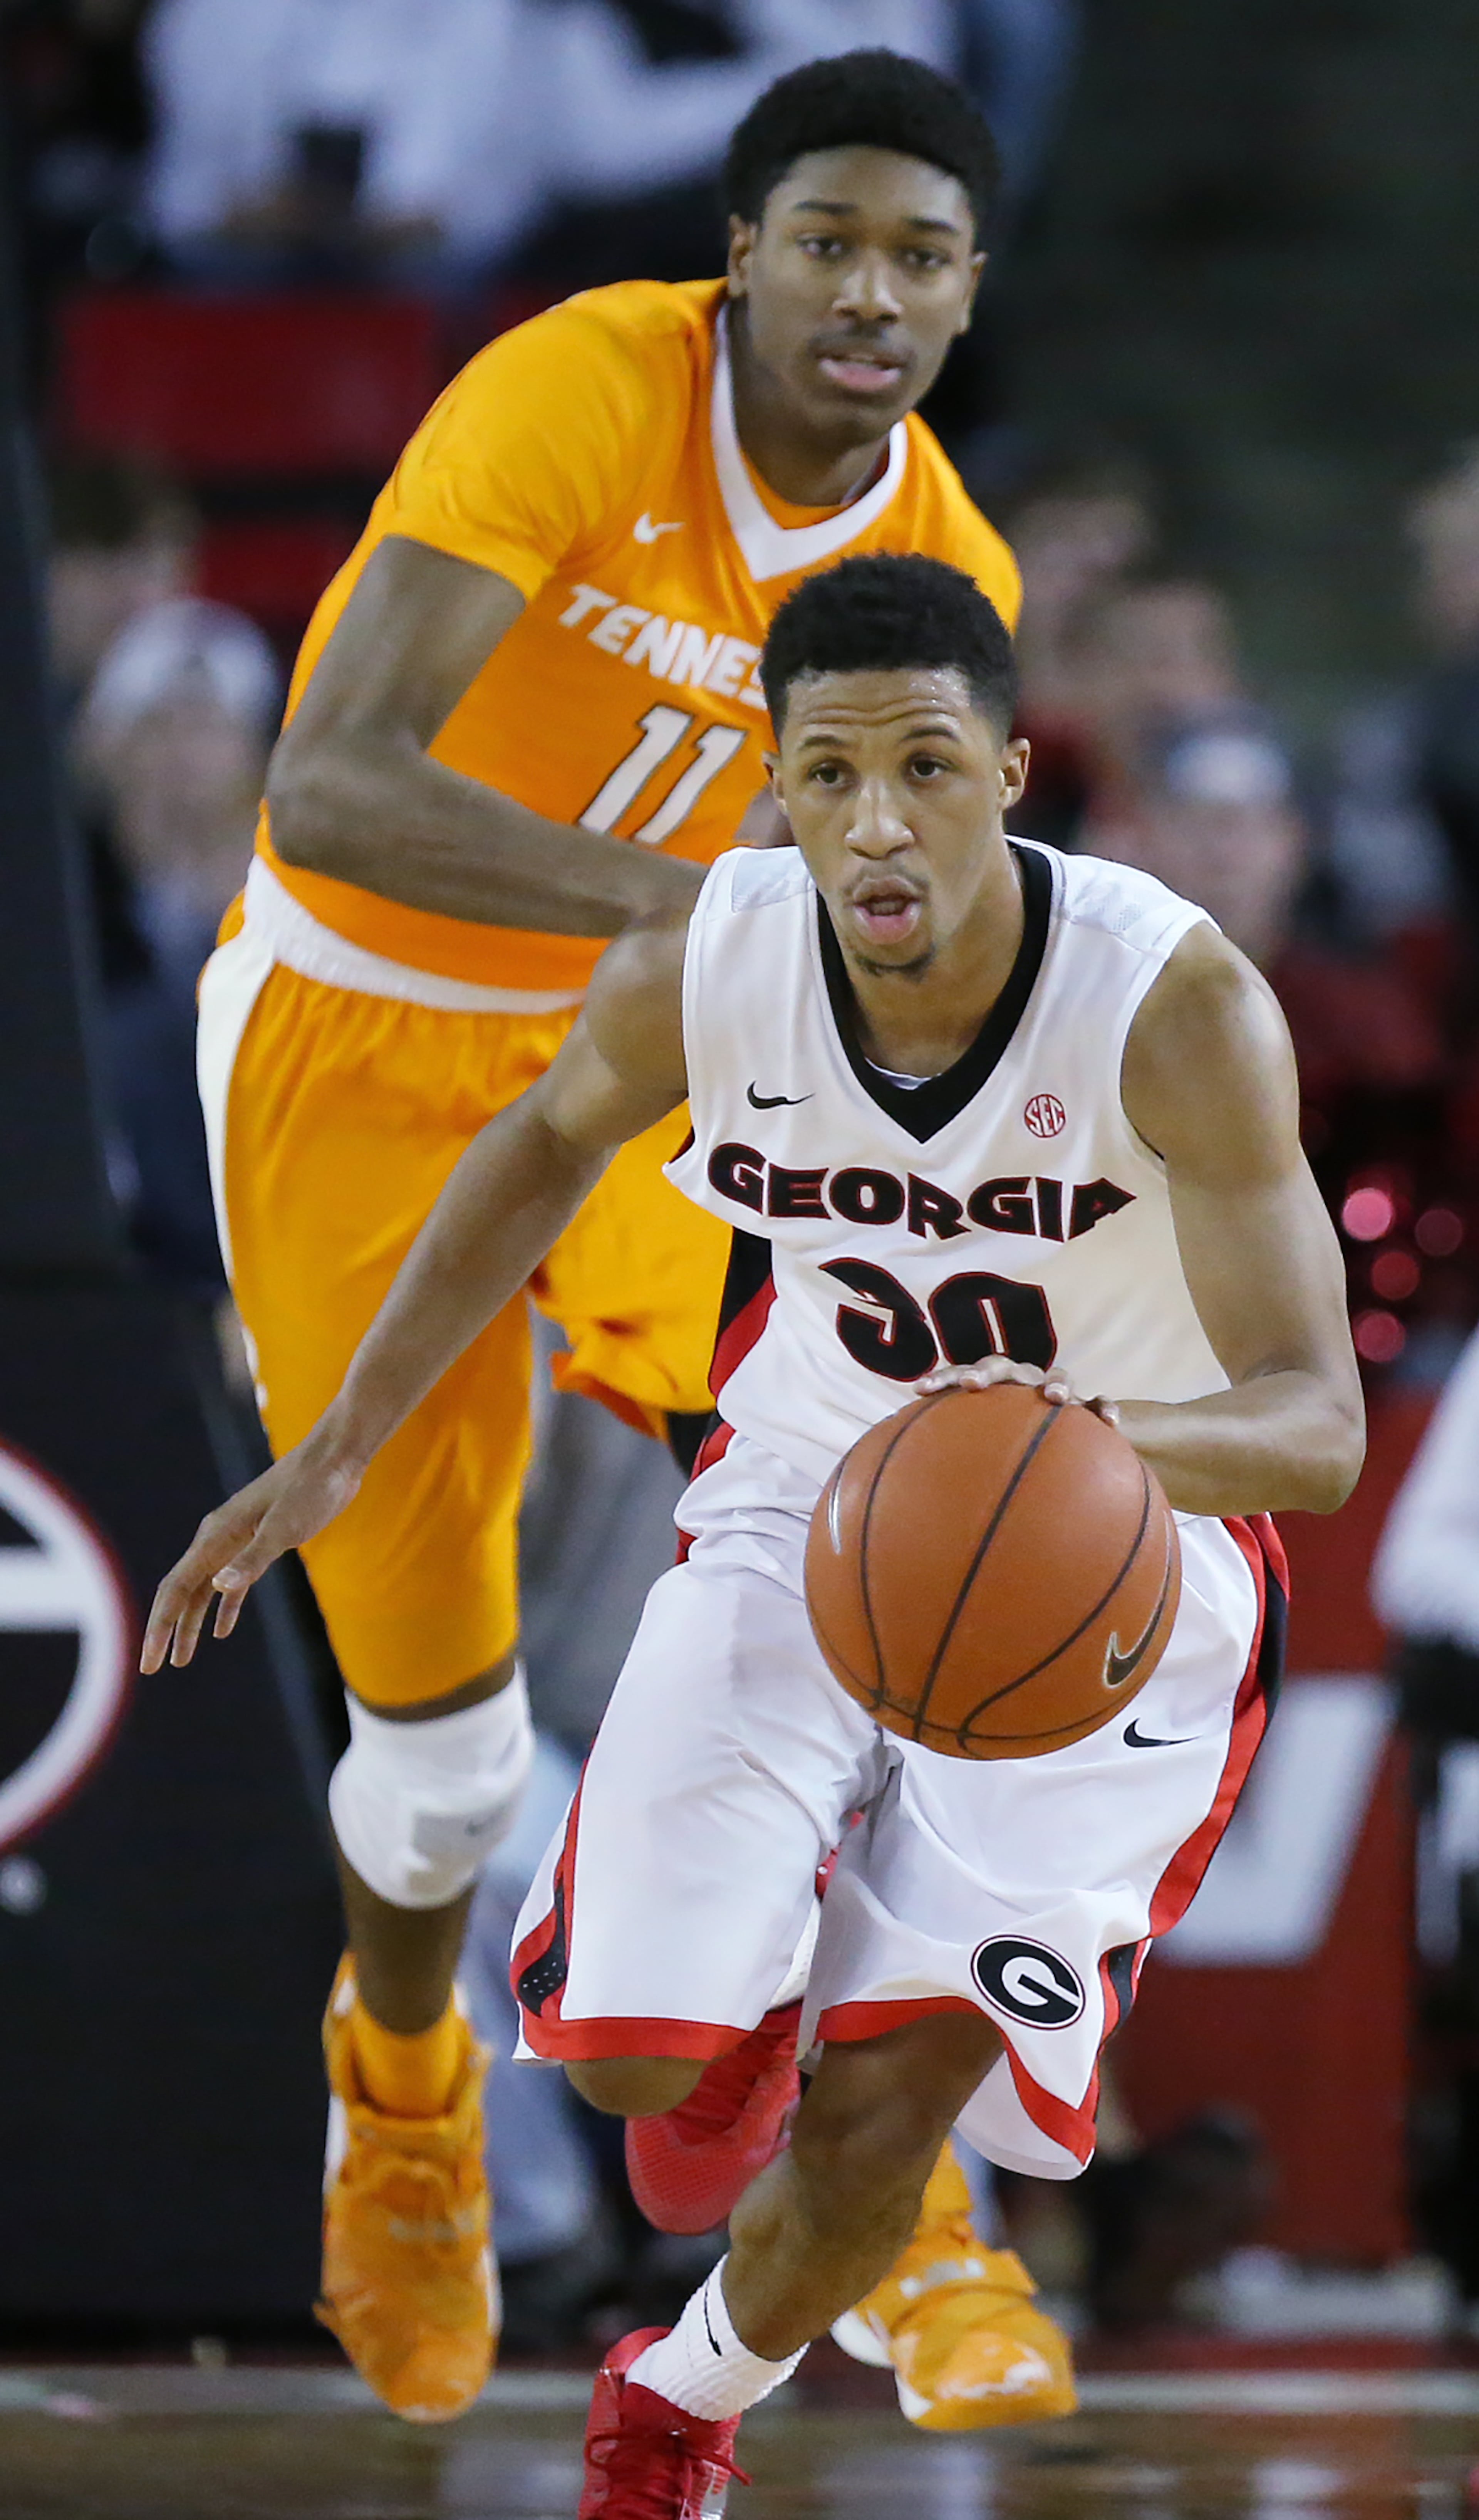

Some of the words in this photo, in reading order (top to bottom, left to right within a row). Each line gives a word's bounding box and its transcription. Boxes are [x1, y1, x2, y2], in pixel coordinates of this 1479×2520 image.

[576, 703, 749, 844] 11
[1026, 1096, 1065, 1137] SEC
[707, 1142, 1137, 1243] GEORGIA
[817, 1257, 1058, 1382] 30
[976, 1940, 1079, 2023] G
